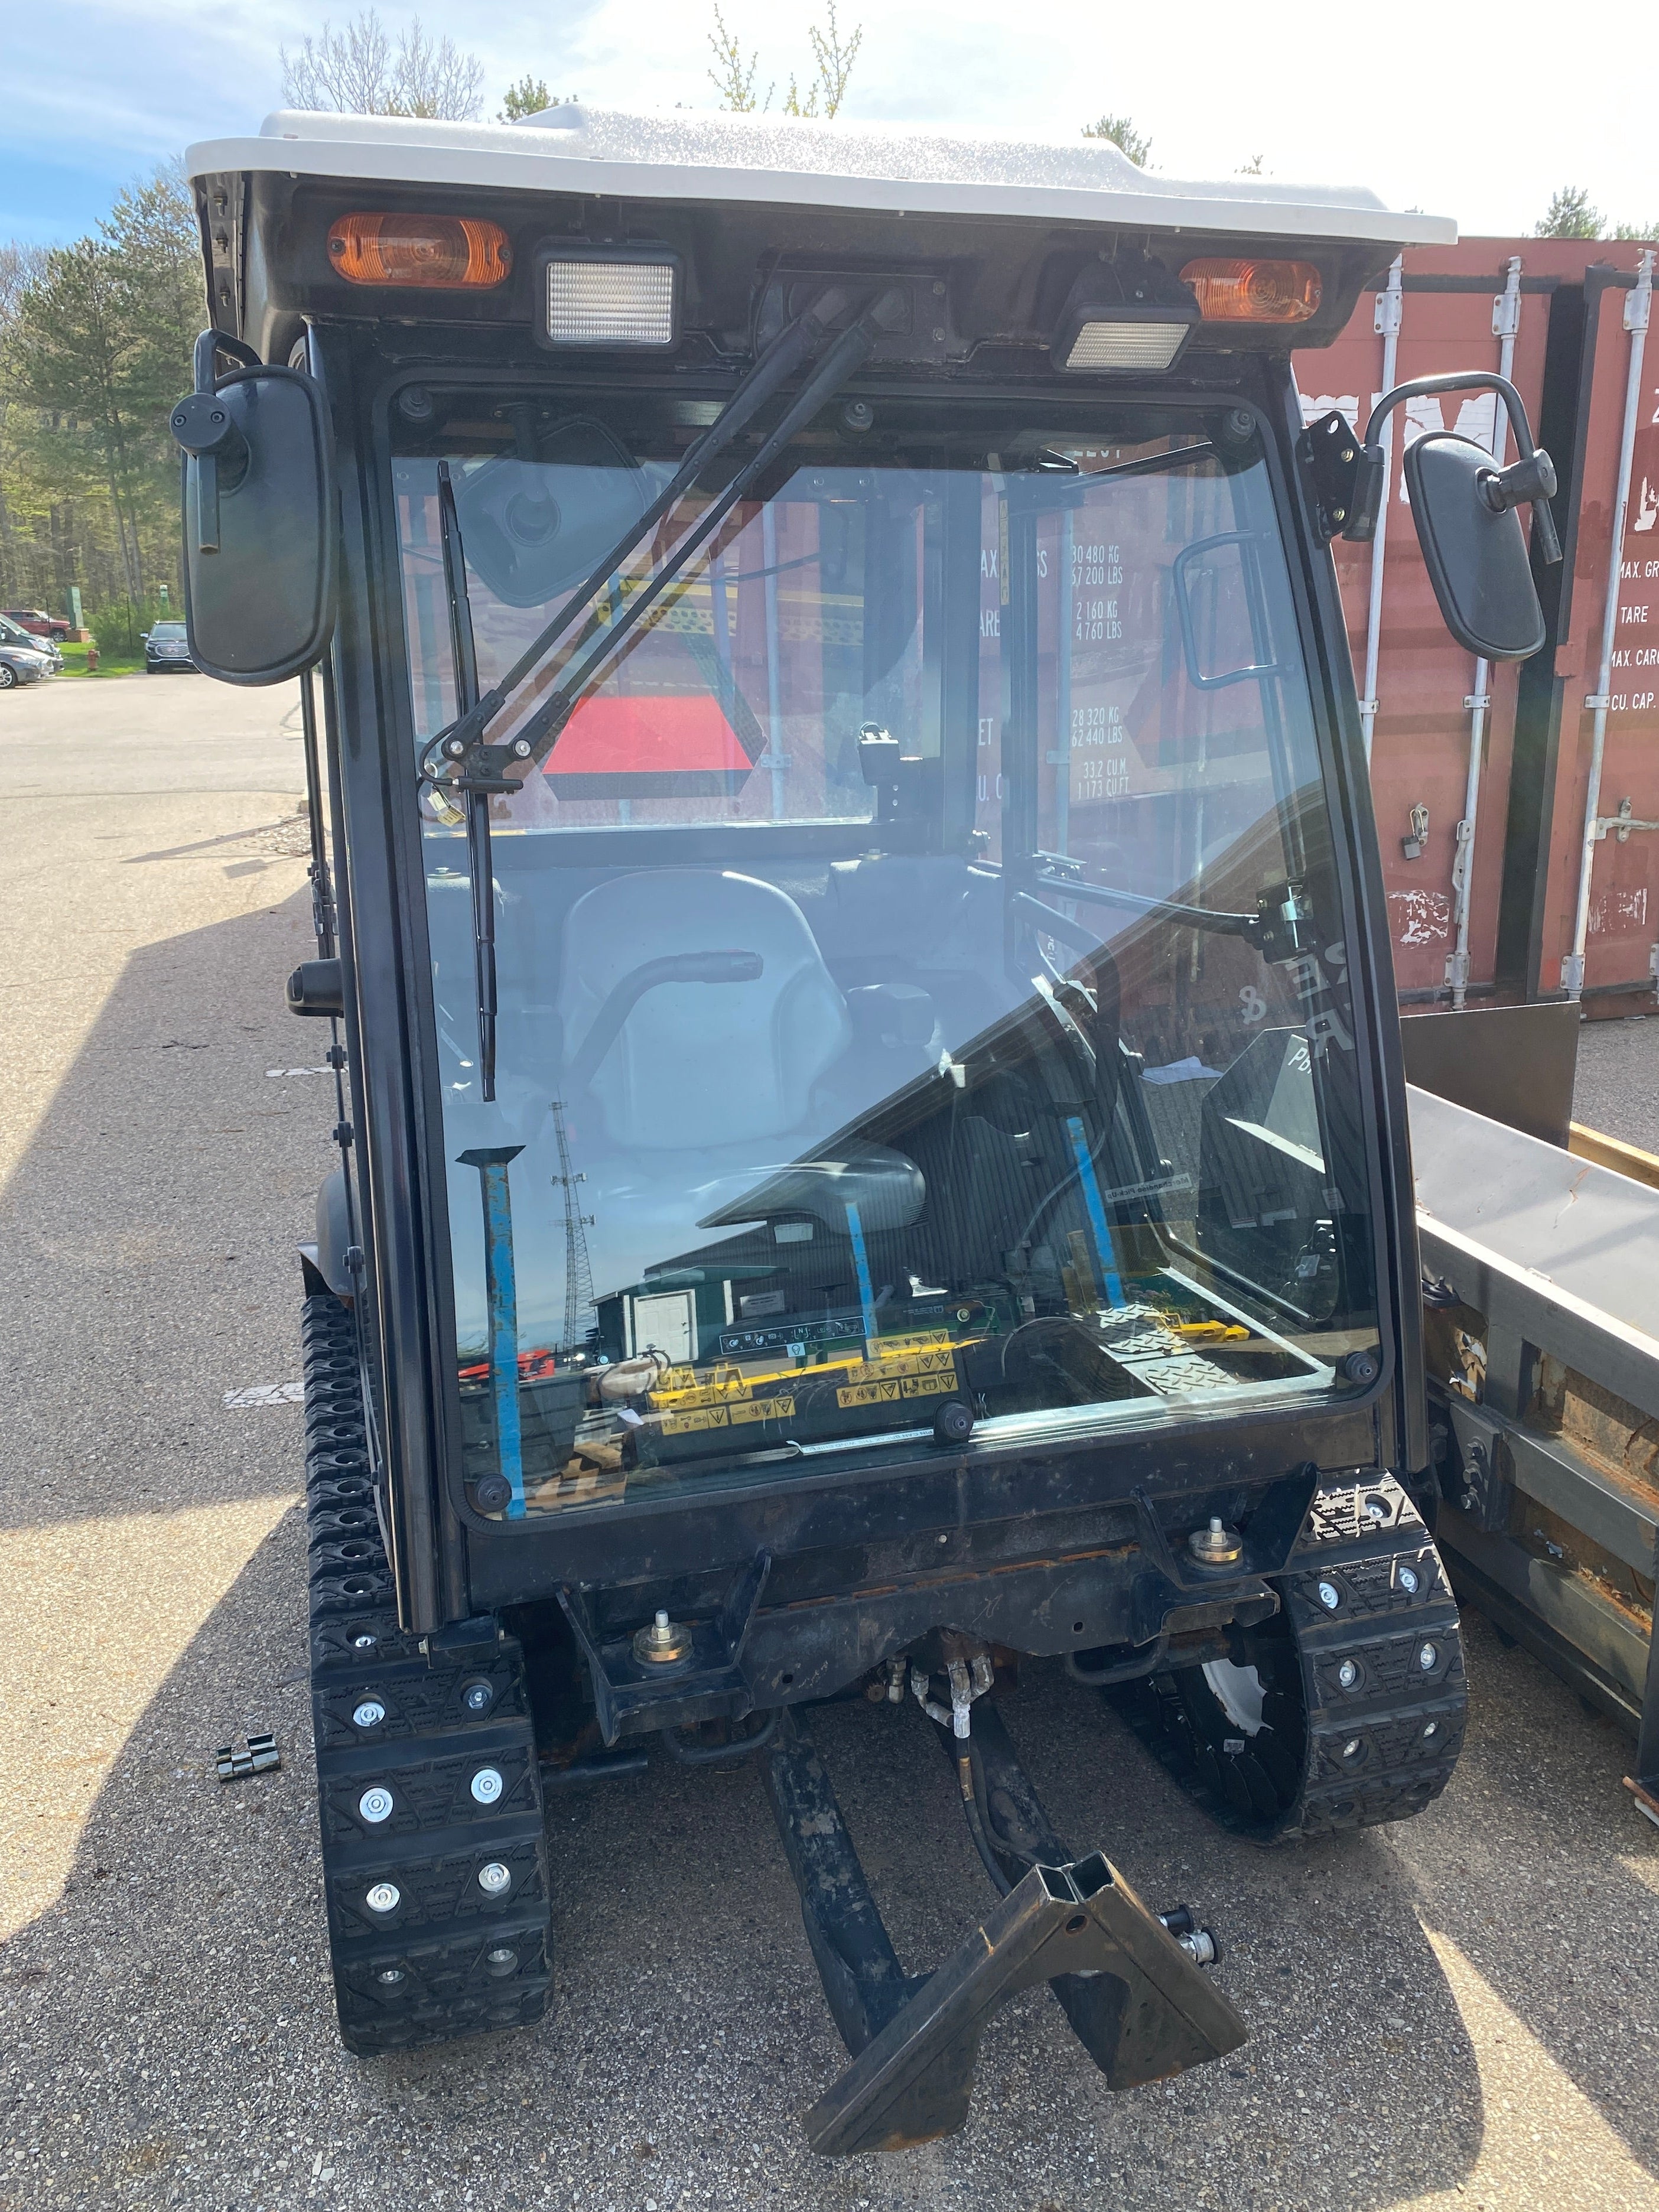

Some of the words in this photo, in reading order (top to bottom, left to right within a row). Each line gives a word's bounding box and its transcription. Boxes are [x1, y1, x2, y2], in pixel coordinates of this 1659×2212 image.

[981, 549, 1000, 578] AX.
[1072, 545, 1083, 564] 30
[1086, 545, 1104, 564] 480
[1108, 545, 1119, 563] KG
[1086, 566, 1104, 585] 200
[1108, 566, 1123, 584] LBS
[1076, 602, 1082, 620] 2
[1087, 601, 1103, 619] 160
[1107, 600, 1117, 619] KG
[1621, 606, 1649, 623] TARE
[980, 610, 1000, 637] ARE
[1076, 622, 1082, 640] 4
[1085, 622, 1103, 640] 760
[1107, 621, 1122, 639] LBS
[1612, 694, 1628, 711] CU.
[1632, 692, 1656, 709] CAP.
[1072, 709, 1084, 727] 28
[1087, 707, 1105, 726] 320
[1109, 706, 1119, 724] KG
[978, 718, 993, 746] ET
[1072, 730, 1084, 747] 62
[1086, 727, 1104, 746] 440
[1108, 726, 1123, 744] LBS
[1084, 760, 1103, 779] 33.2
[1087, 780, 1102, 799] 173
